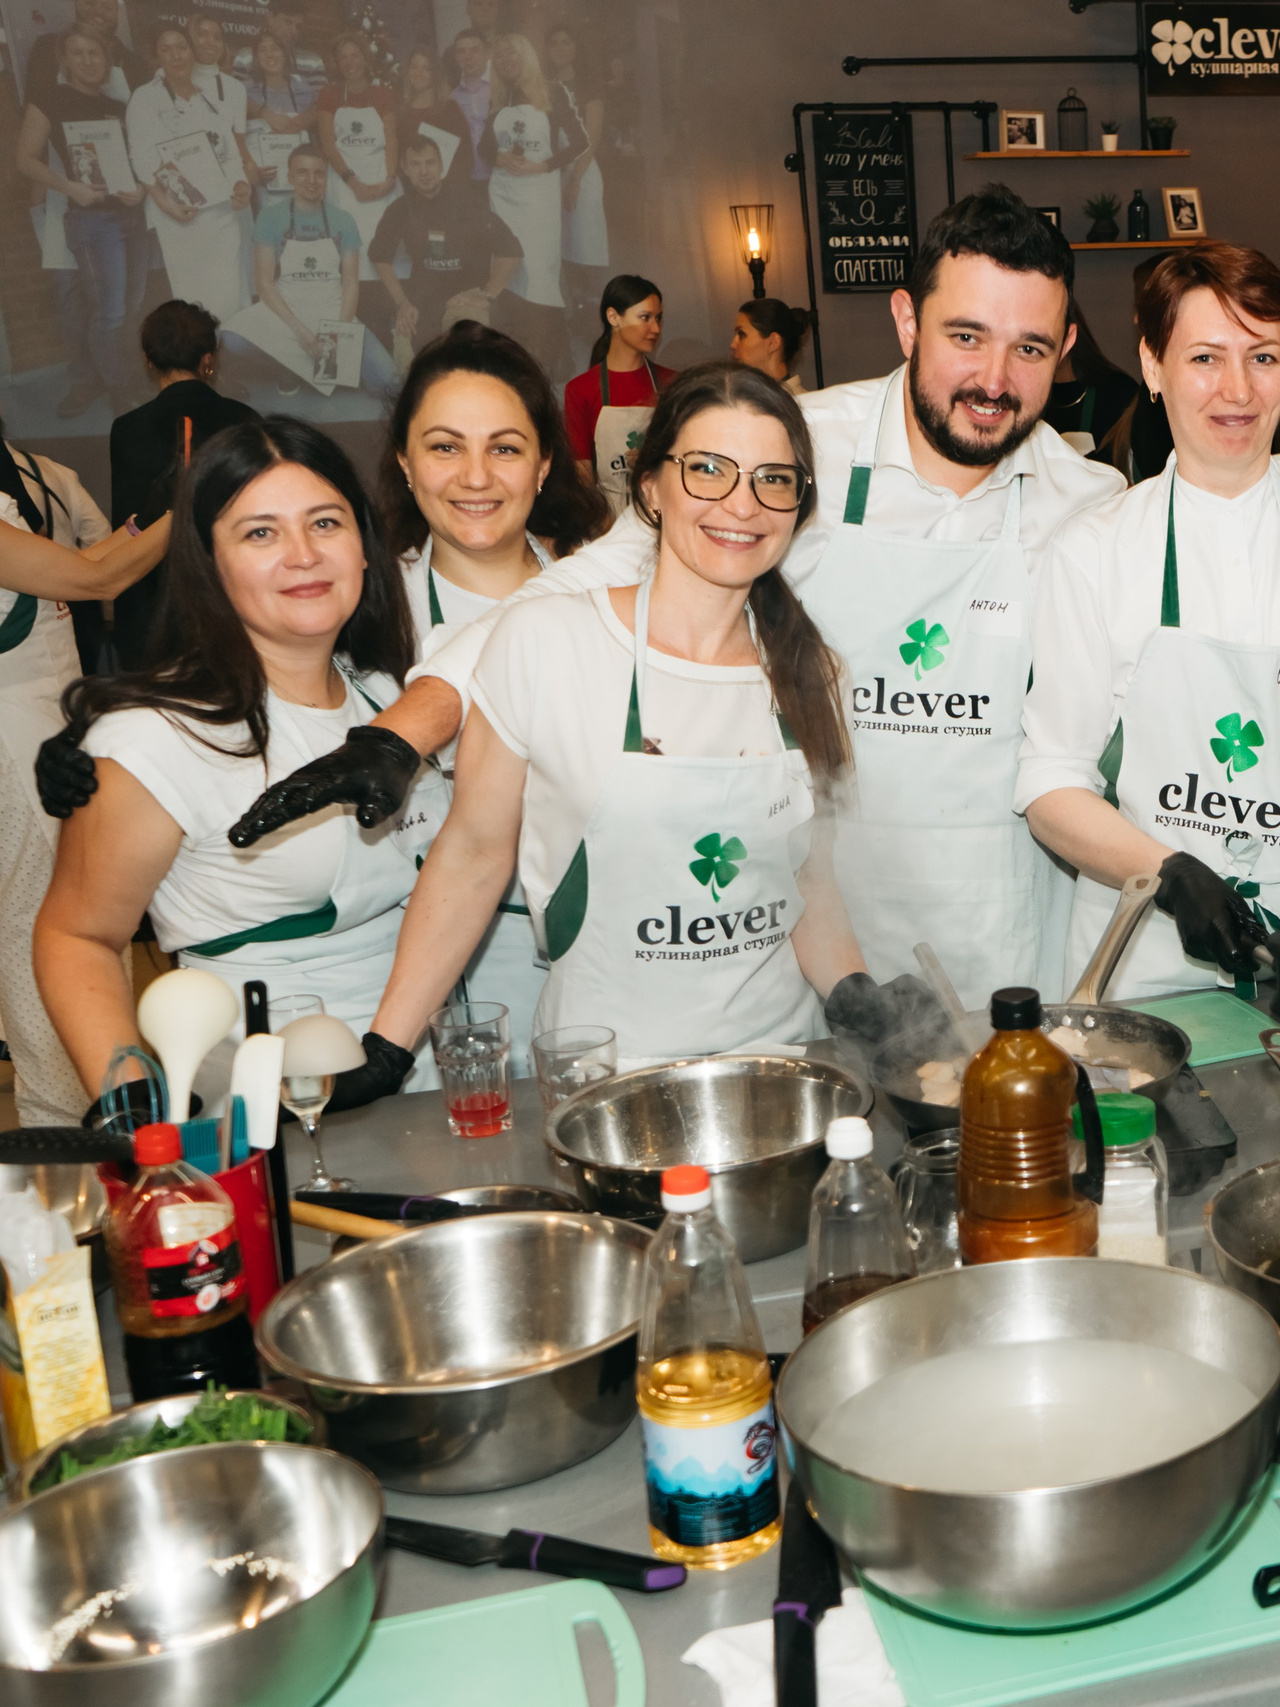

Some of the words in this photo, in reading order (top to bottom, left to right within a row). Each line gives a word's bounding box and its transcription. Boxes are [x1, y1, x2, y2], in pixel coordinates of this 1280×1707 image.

[1190, 61, 1280, 79] кулинарная
[852, 178, 878, 197] ЕСТЬ
[828, 235, 909, 248] ОБЯЗАНА
[834, 258, 905, 283] СПАГЕТТИ
[969, 599, 1009, 613] АНТОН
[852, 676, 990, 720] clever
[853, 719, 939, 735] улинарная
[943, 724, 992, 737] студия
[636, 898, 787, 945] clever
[635, 943, 740, 962] кулинарная
[743, 930, 787, 951] студия
